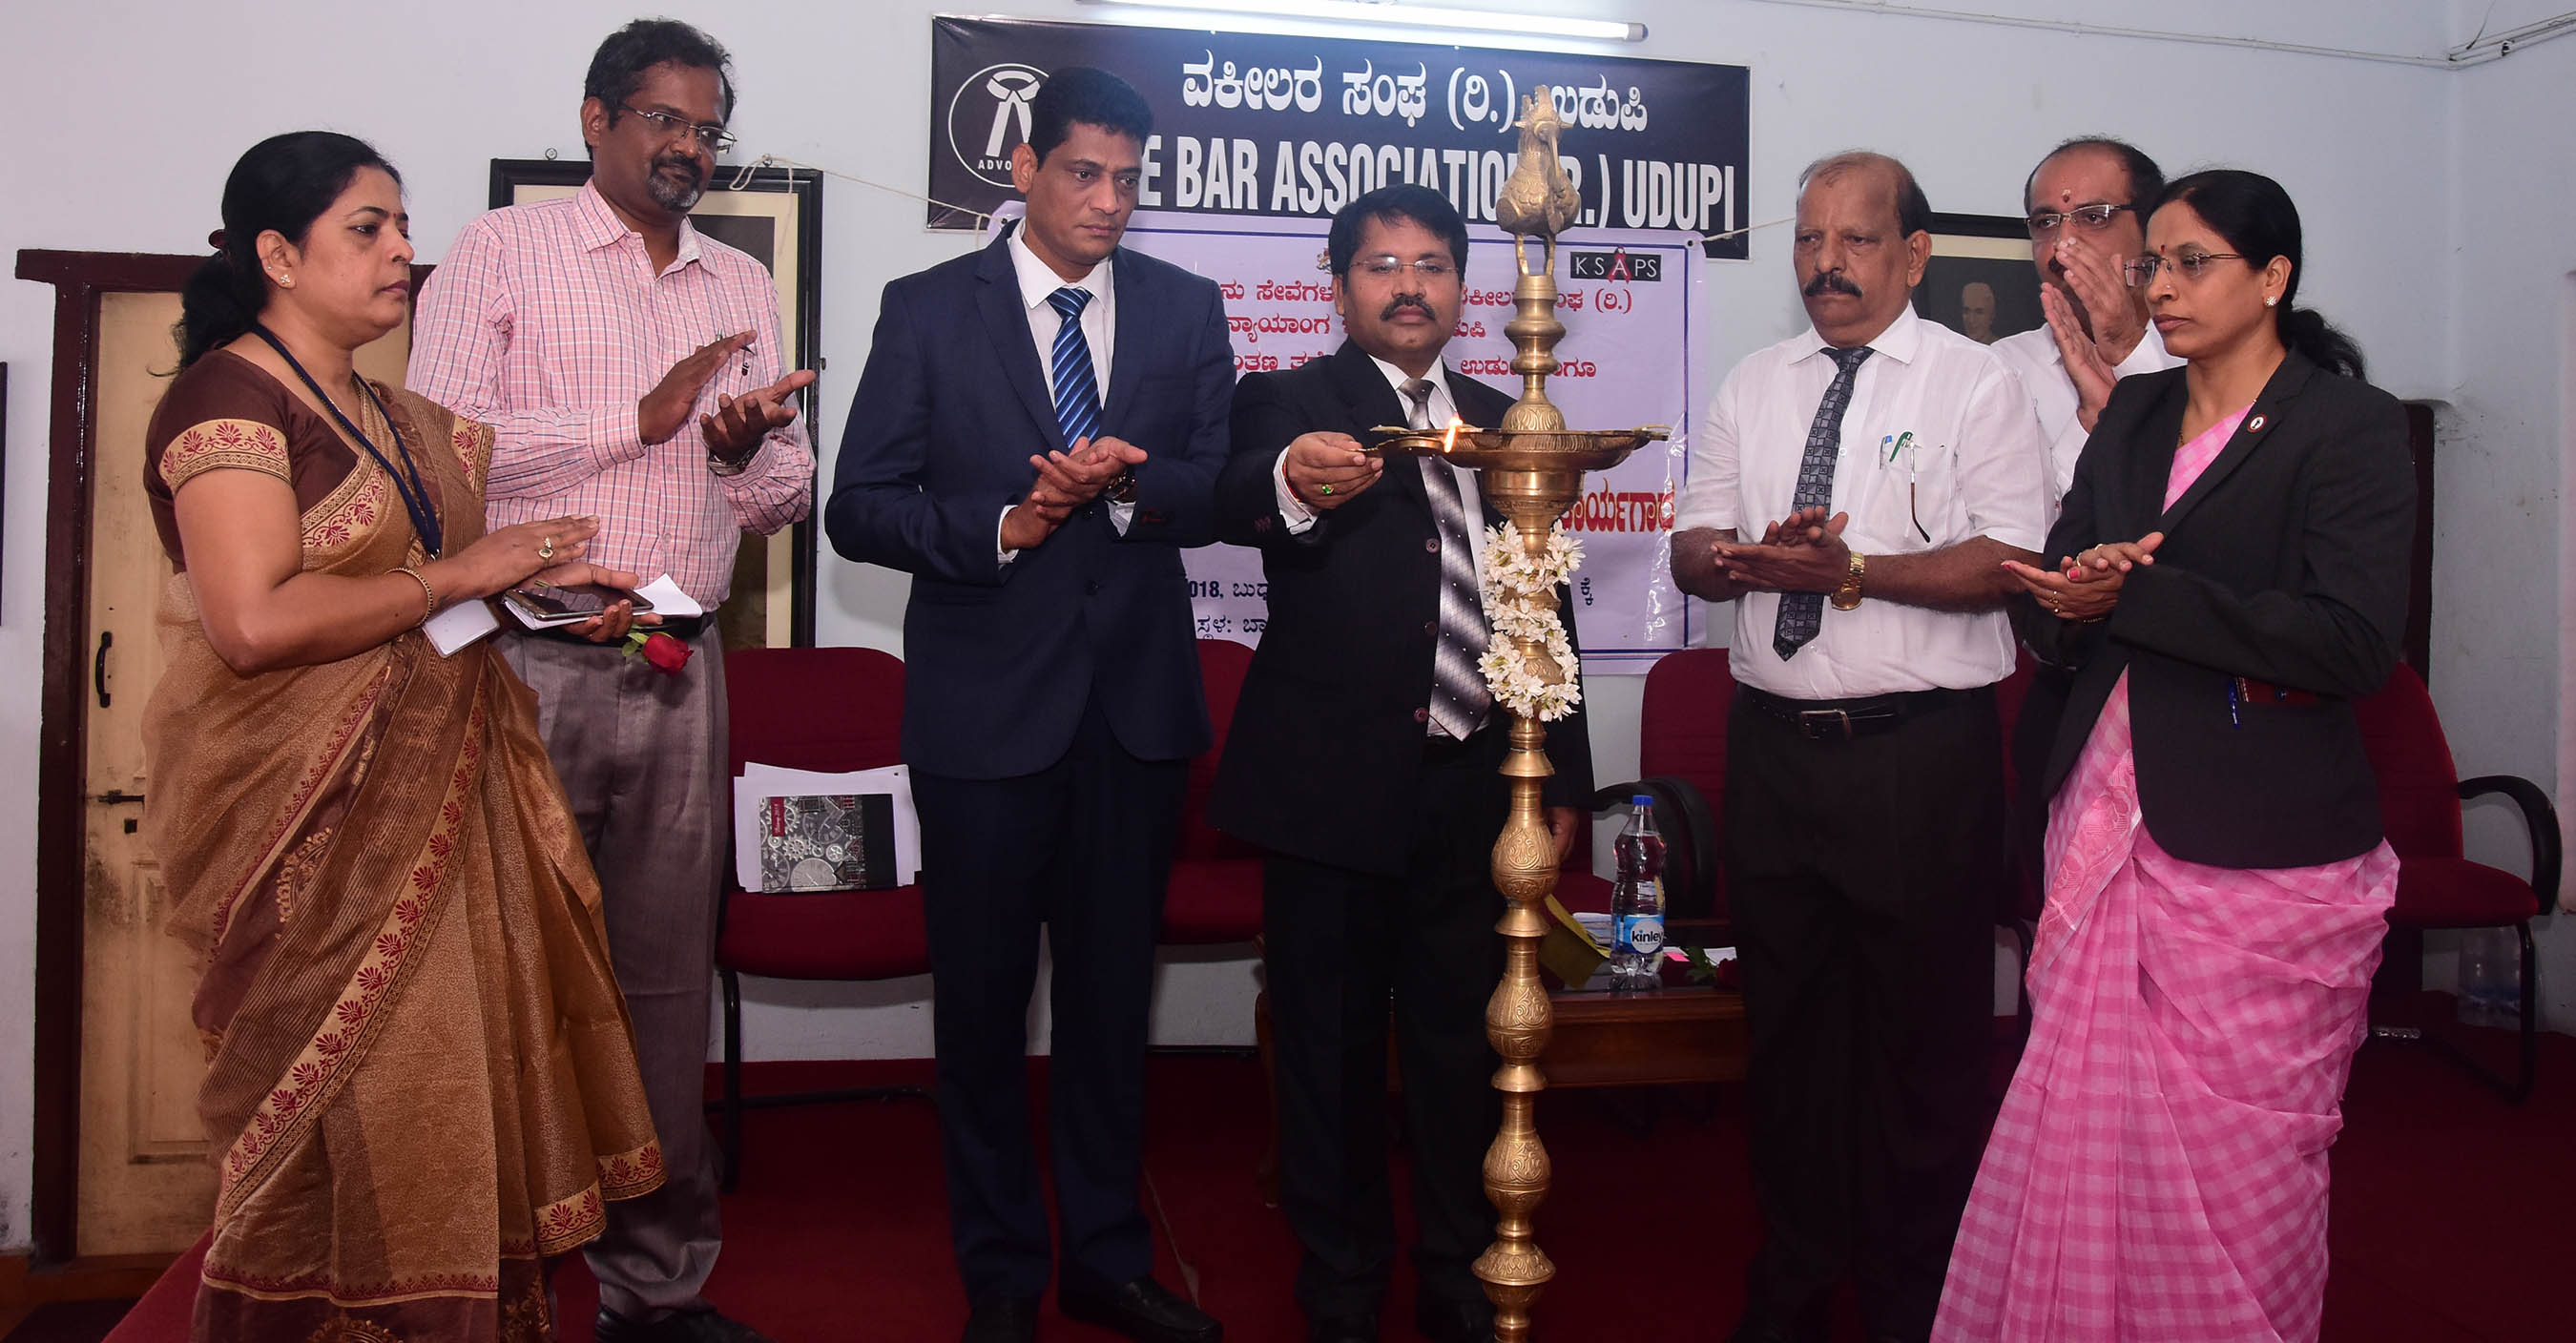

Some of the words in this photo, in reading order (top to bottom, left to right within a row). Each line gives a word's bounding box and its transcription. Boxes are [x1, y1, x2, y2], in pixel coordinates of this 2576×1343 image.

[1182, 49, 1322, 113] ವಕೀಲರ
[1342, 58, 1426, 128] ಸಂಘ
[978, 159, 1012, 171] ADVO
[1176, 135, 1258, 210] BAR
[1271, 140, 1519, 221] ASSOCIATIO
[1623, 159, 1735, 232] UDUPI
